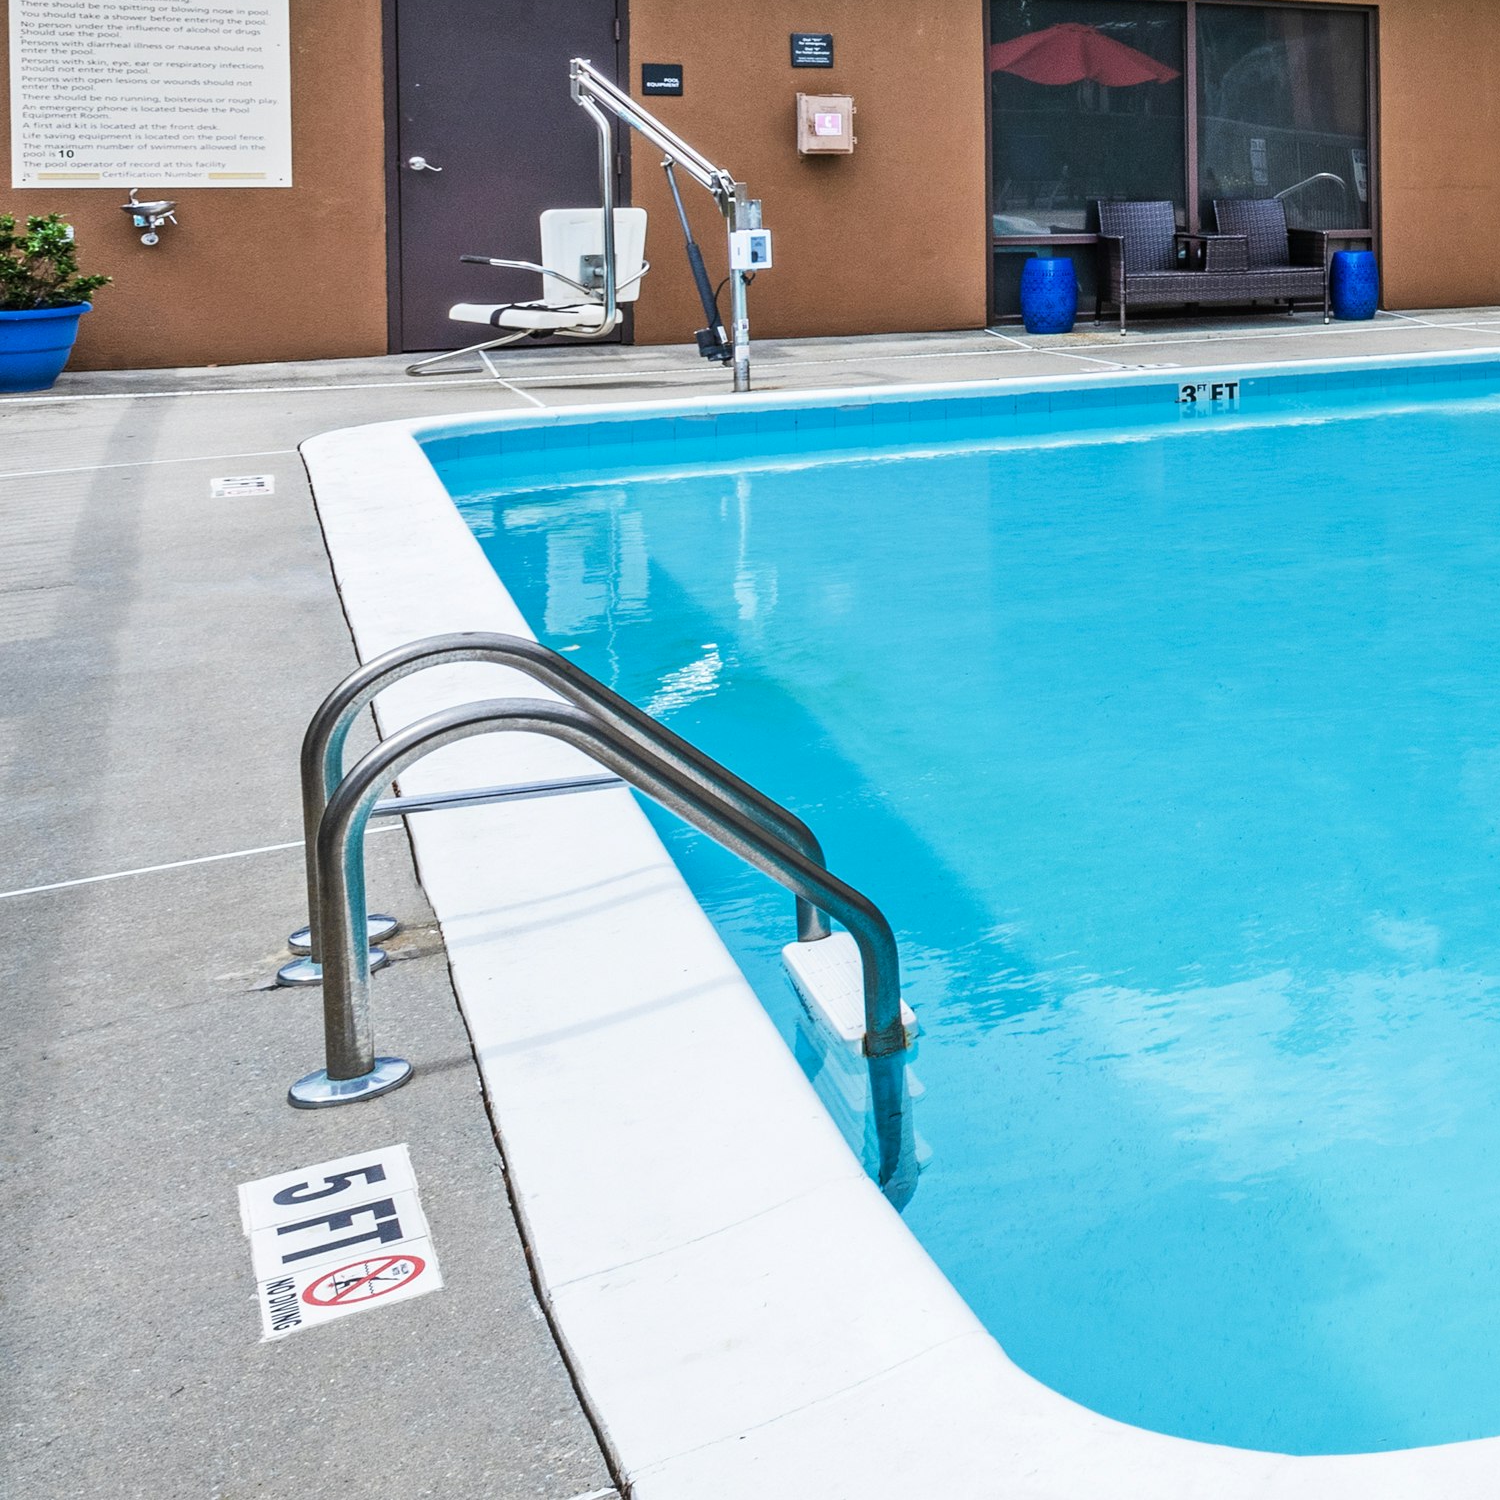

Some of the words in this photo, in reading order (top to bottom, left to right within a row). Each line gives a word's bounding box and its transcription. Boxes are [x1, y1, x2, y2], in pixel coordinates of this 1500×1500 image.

[21, 0, 49, 8] There
[119, 4, 156, 13] spitting
[171, 6, 210, 15] blowing
[126, 24, 170, 32] influence
[186, 26, 220, 34] alcohol
[235, 28, 261, 36] drugs
[184, 17, 224, 26] entering
[23, 151, 45, 159] pool
[1181, 385, 1197, 403] 3
[1211, 382, 1238, 401] FT
[273, 1163, 386, 1206] 5
[277, 1197, 404, 1264] FT
[266, 1277, 296, 1295] NO
[269, 1293, 302, 1331] DIVING
